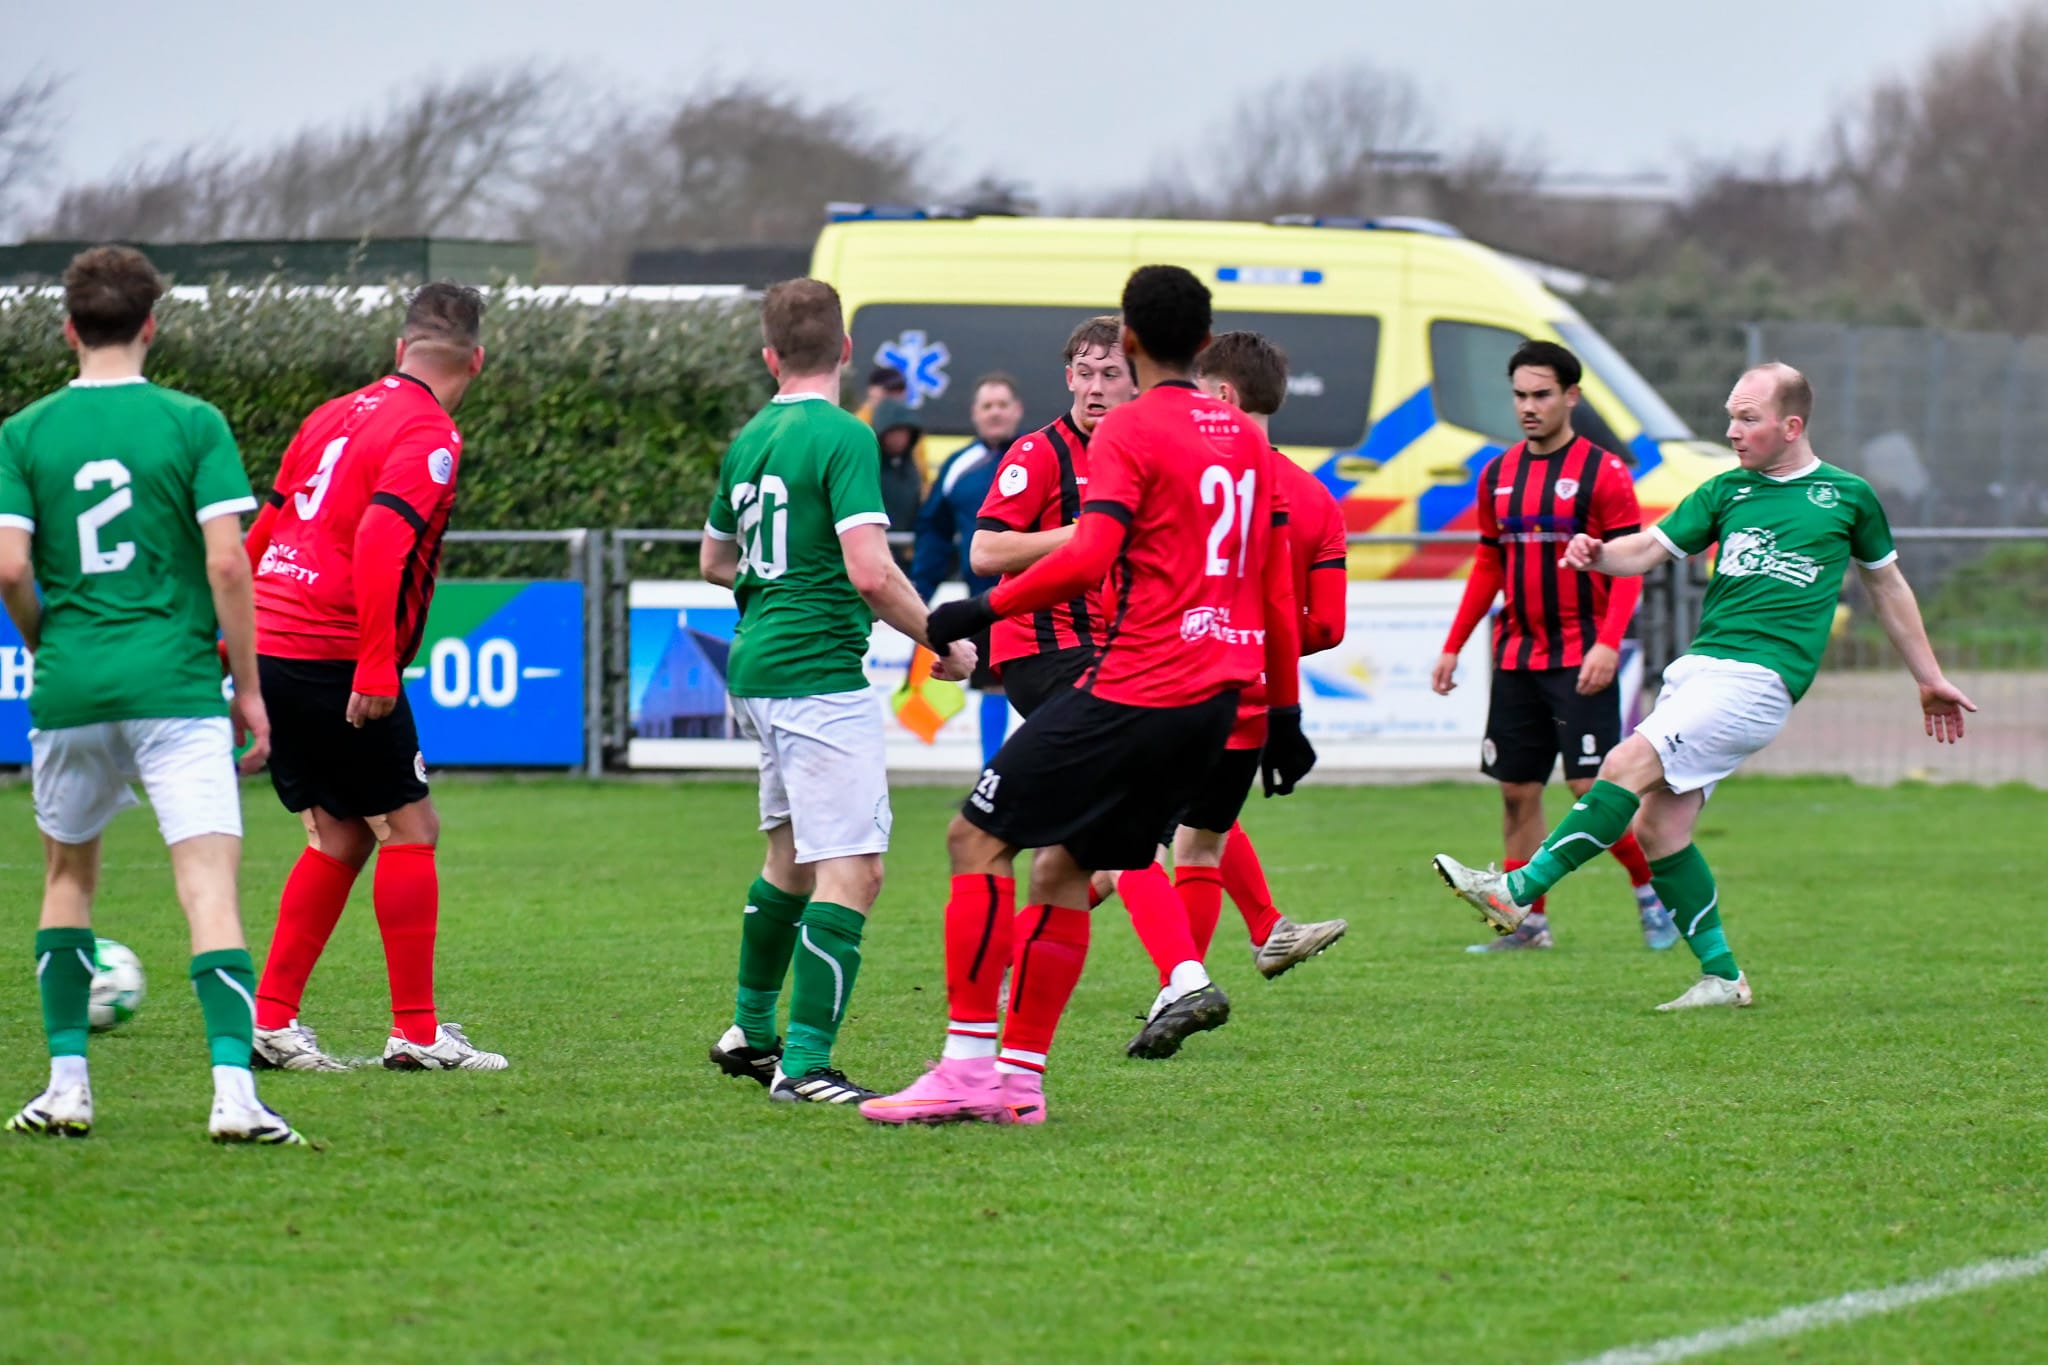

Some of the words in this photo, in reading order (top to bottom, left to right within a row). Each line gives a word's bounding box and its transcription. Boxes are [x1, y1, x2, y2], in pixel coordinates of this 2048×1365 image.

[74, 459, 136, 574] 2
[1199, 464, 1256, 578] 21
[976, 768, 1001, 800] 21
